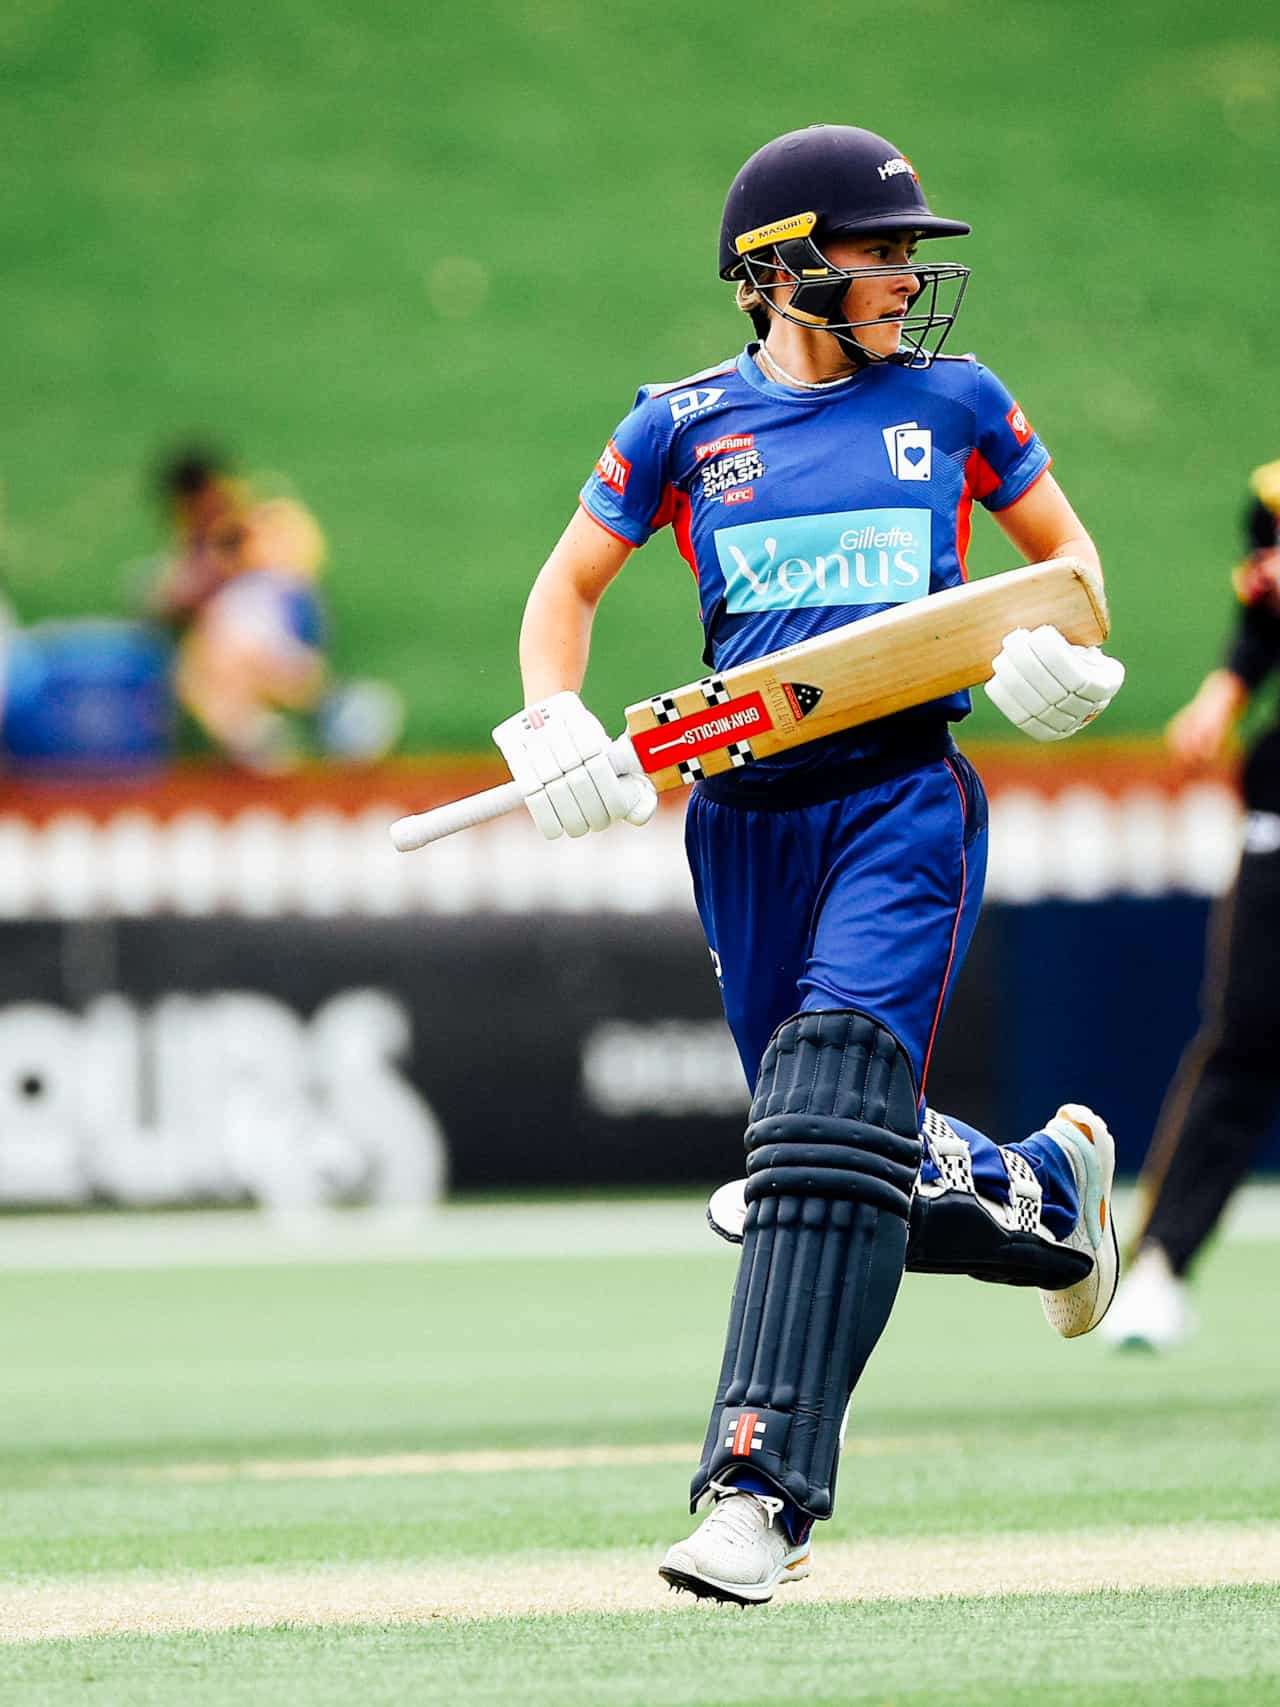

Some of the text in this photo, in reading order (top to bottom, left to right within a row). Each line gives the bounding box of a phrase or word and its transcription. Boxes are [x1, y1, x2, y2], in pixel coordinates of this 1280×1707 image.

[758, 219, 802, 239] MASURI
[673, 401, 729, 429] DYNASTY
[701, 449, 761, 484] SUPER
[703, 463, 766, 499] SMASH
[726, 489, 751, 503] KFC
[839, 525, 913, 551] Gillette
[728, 537, 921, 596] Venus
[684, 706, 760, 745] GRAY-NICOLLS
